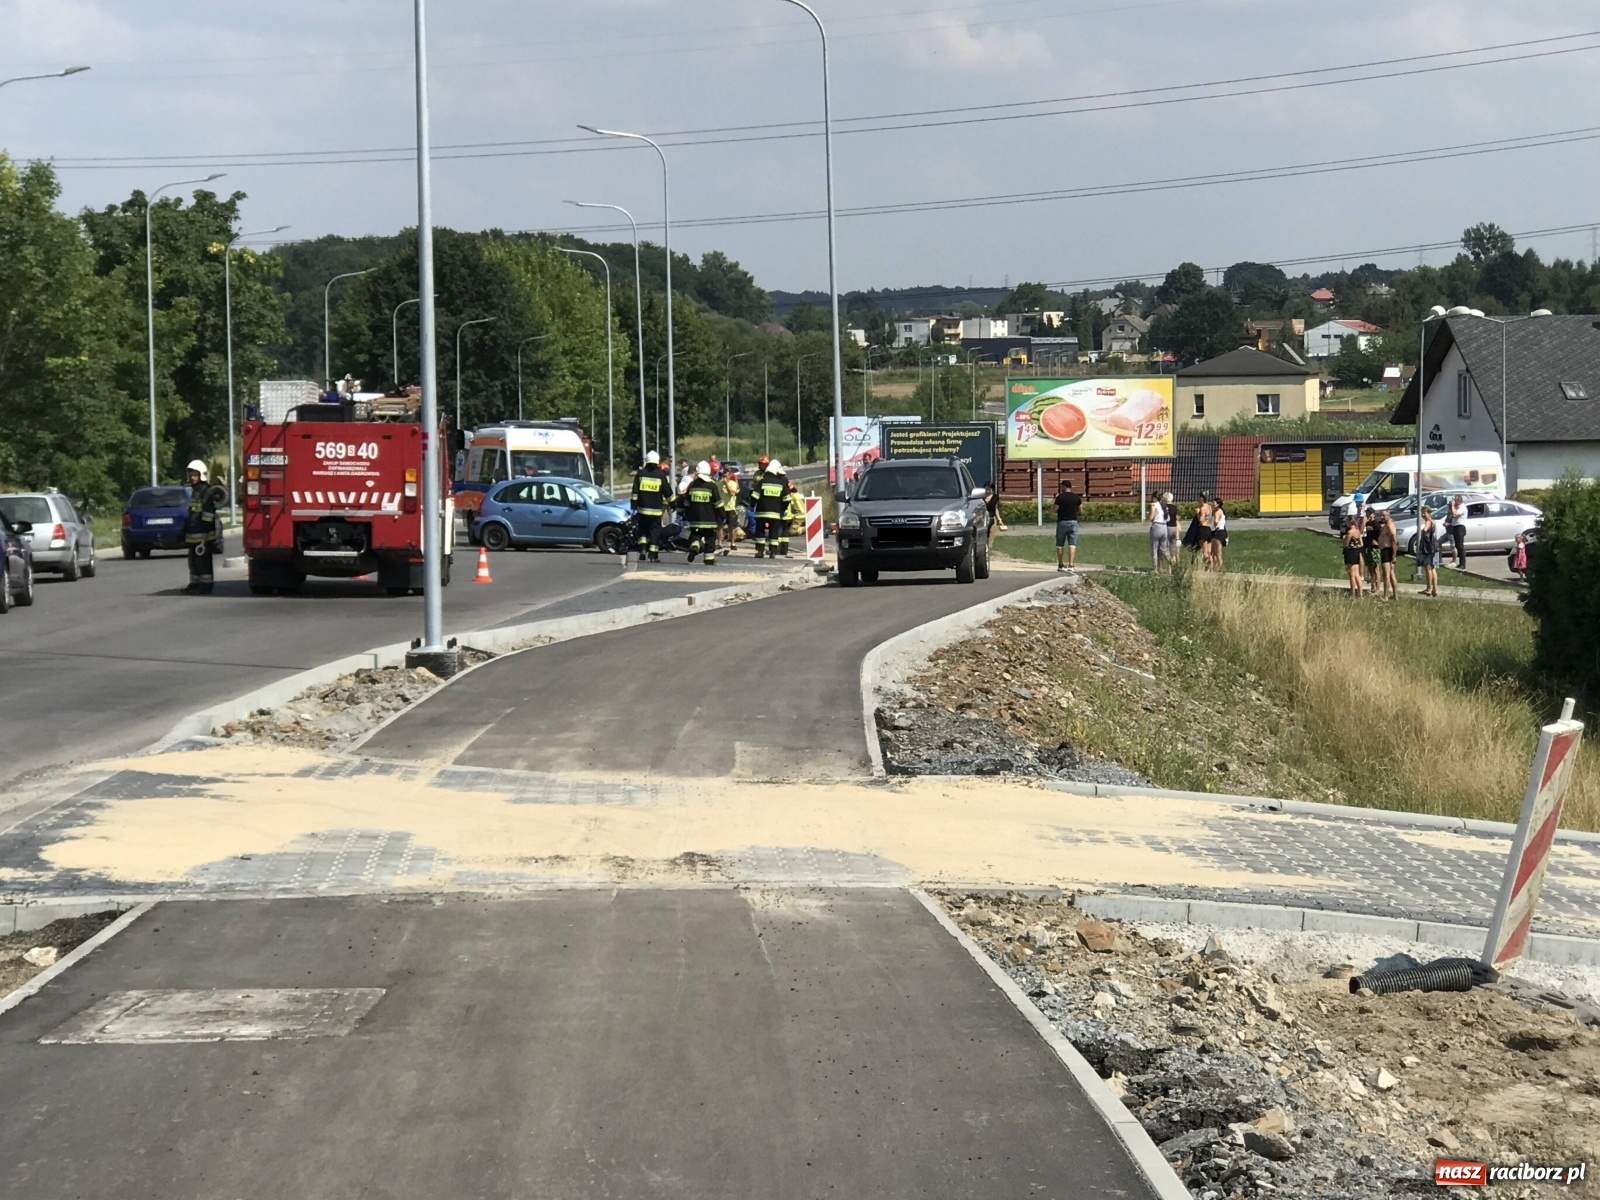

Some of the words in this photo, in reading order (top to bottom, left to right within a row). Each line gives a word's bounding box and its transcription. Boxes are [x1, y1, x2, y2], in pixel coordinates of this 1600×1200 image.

[1012, 383, 1035, 393] dino
[315, 441, 347, 459] 569
[357, 442, 379, 460] 40
